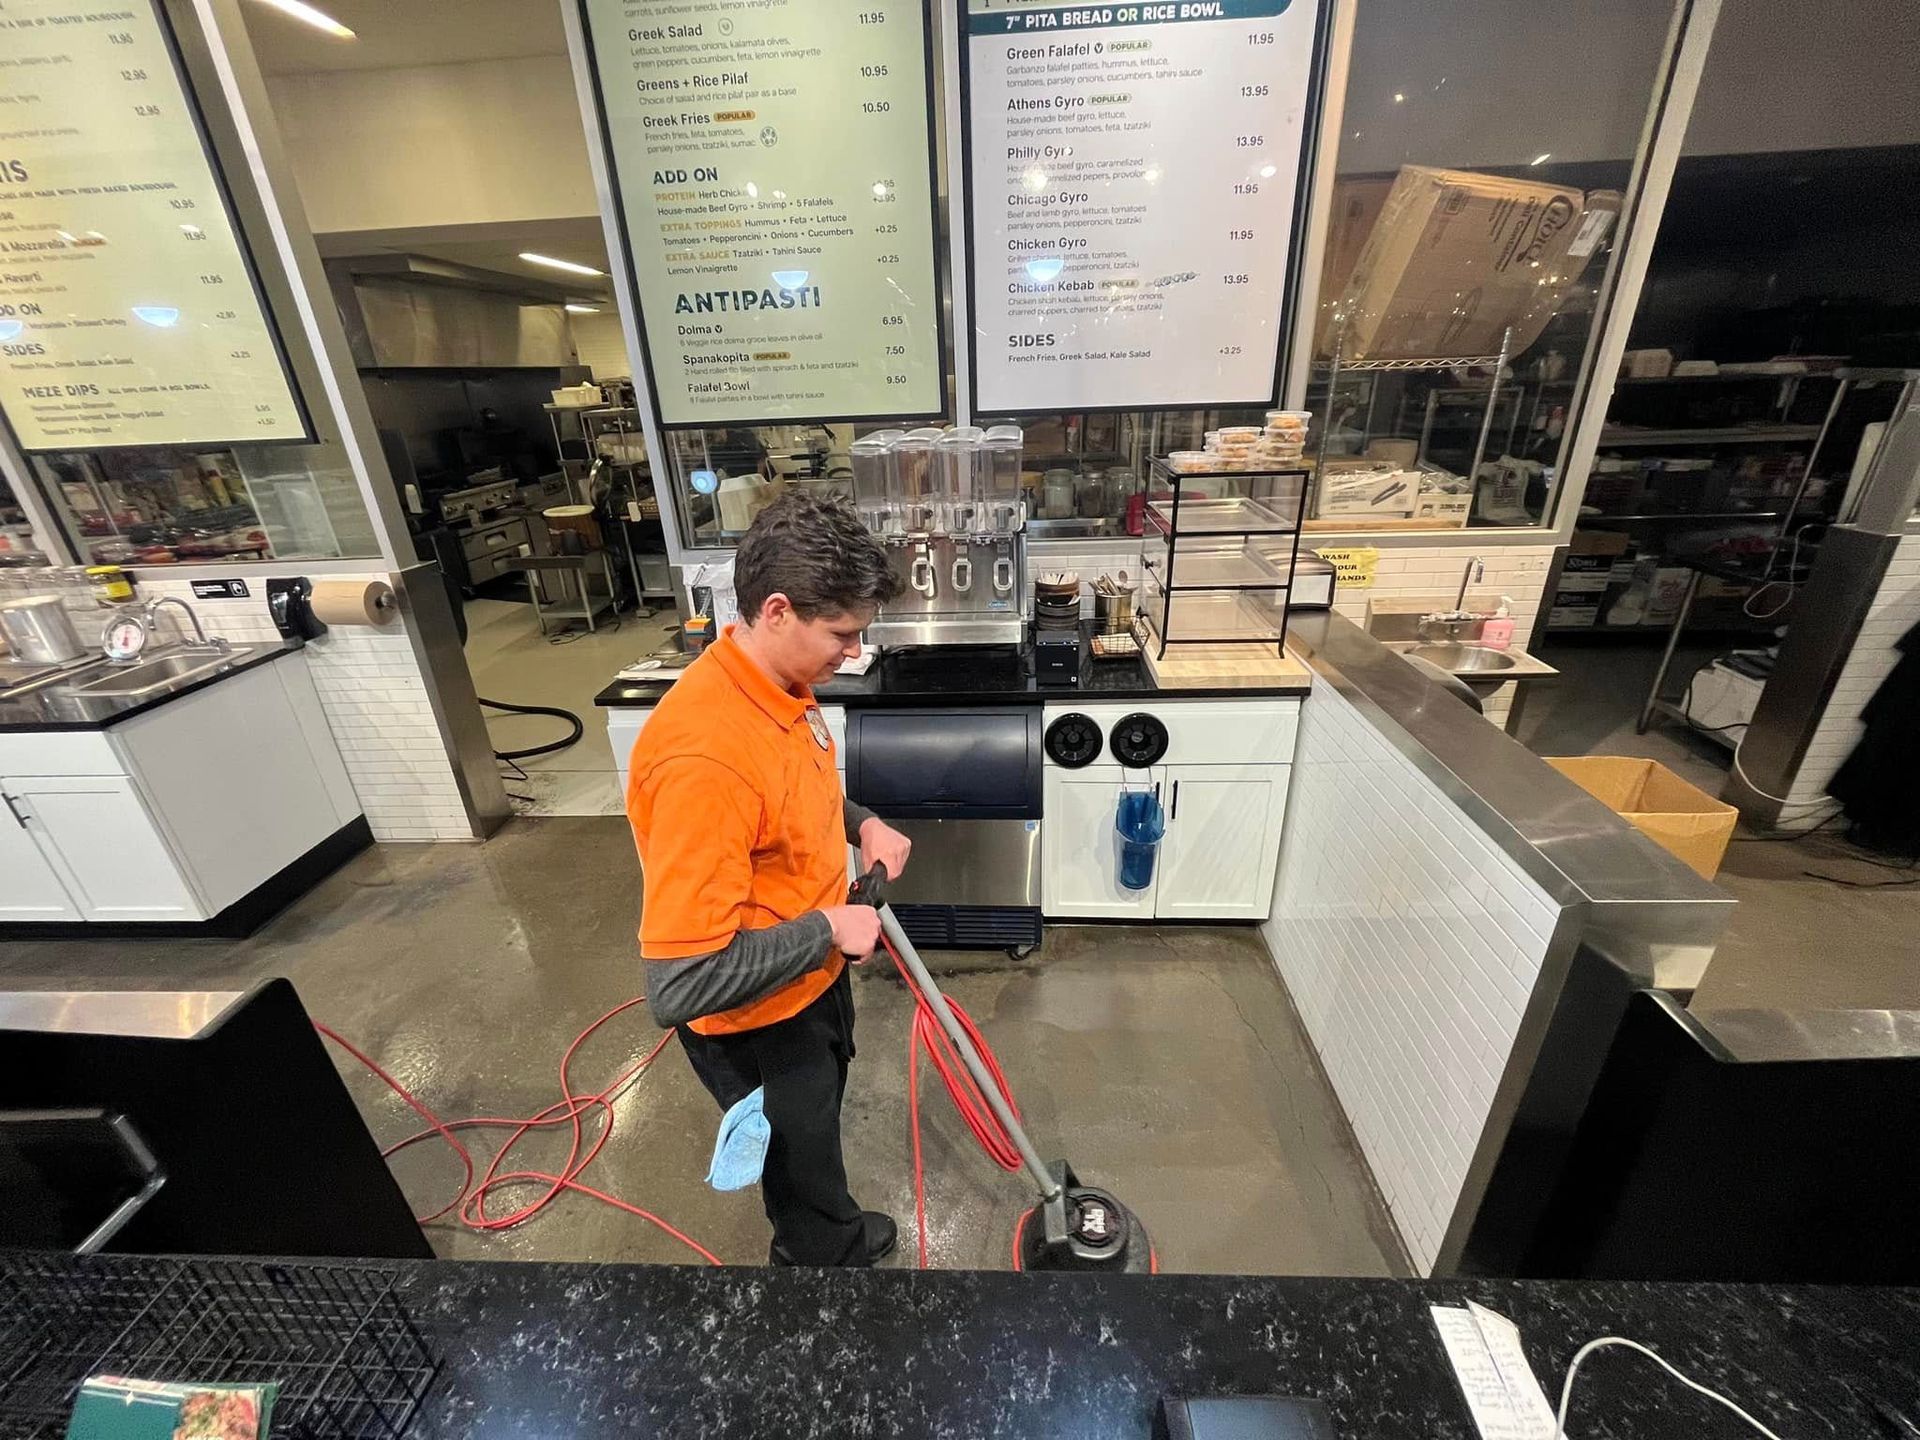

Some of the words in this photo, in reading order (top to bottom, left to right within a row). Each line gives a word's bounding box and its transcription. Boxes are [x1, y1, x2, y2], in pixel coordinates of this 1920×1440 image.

[859, 12, 884, 24] 11.95
[1006, 16, 1021, 30] 7"
[1026, 13, 1057, 28] PITA
[1063, 11, 1112, 26] BREAD
[1117, 8, 1138, 23] OR
[1143, 6, 1175, 21] RICE
[1180, 3, 1224, 18] BOWL
[108, 33, 133, 44] 11.95
[629, 28, 665, 41] Greek
[668, 24, 703, 37] Salad
[1247, 33, 1274, 46] 11.95
[1007, 46, 1045, 60] Green
[1049, 42, 1090, 57] Falafel
[1111, 41, 1148, 51] POPULAR
[121, 69, 147, 80] 12.95
[860, 65, 888, 78] 10.95
[637, 77, 680, 92] Greens
[693, 74, 719, 88] Rice
[722, 72, 748, 85] Pilaf
[1241, 86, 1268, 98] 13.95
[862, 102, 890, 113] 10.50
[1007, 98, 1050, 110] Athens
[1055, 96, 1084, 110] Gyro
[1091, 95, 1128, 104] POPULAR
[134, 105, 160, 116] 12.95
[643, 115, 679, 128] Greek
[681, 113, 710, 125] Fries
[716, 111, 752, 121] POPULAR
[1236, 136, 1264, 147] 13.95
[1007, 147, 1041, 160] Philly
[653, 170, 687, 185] ADD
[694, 167, 718, 181] ON
[656, 192, 695, 201] PROTEIN
[699, 191, 718, 199] Herb
[720, 189, 749, 198] Chick
[1233, 183, 1259, 195] 11.95
[1008, 193, 1056, 206] Chicago
[1060, 192, 1088, 205] Gyro
[658, 207, 707, 216] House-made
[729, 204, 747, 212] Gyro
[758, 200, 786, 212] Shrimp
[804, 197, 834, 207] Falafels
[661, 222, 692, 232] EXTRA
[694, 219, 742, 231] TOPPINGS
[745, 218, 780, 228] Hummus
[789, 216, 807, 225] Feta
[816, 213, 847, 223] Lettuce
[876, 225, 897, 233] +0.25
[1229, 229, 1254, 241] 11.95
[663, 236, 700, 247] Tomatoes
[709, 232, 761, 244] Pepperoncini
[771, 230, 798, 240] Onions
[808, 226, 854, 238] Cucumbers
[1008, 238, 1055, 250] Chicken
[1059, 237, 1087, 250] Gyro
[665, 252, 696, 262] EXTRA
[699, 250, 730, 260] SAUCE
[733, 248, 763, 258] Tzatziki
[773, 246, 795, 256] Tahini
[797, 246, 822, 255] Sauce
[878, 254, 899, 263] +0.25
[668, 266, 694, 275] Lemon
[696, 263, 738, 275] Vinaigrette
[201, 275, 222, 284] 11.95
[1223, 274, 1248, 285] 13.95
[1008, 282, 1054, 294] Chicken
[1058, 280, 1094, 292] Kebab
[675, 286, 821, 314] ANTIPASTI
[20, 303, 42, 315] ON
[882, 316, 903, 326] 6.95
[678, 325, 712, 335] Dolma
[1008, 334, 1055, 348] SIDES
[3, 344, 45, 356] SIDES
[885, 346, 904, 355] 7.50
[683, 352, 750, 366] Spanakopita
[1008, 354, 1035, 363] French
[1037, 353, 1057, 362] Fries,
[1059, 352, 1082, 361] Greek
[1084, 351, 1108, 360] Salad,
[1110, 351, 1128, 359] Kale
[1130, 350, 1151, 358] Salad
[886, 375, 907, 385] 9.50
[22, 387, 63, 398] MEZE
[66, 384, 100, 396] DIPS
[688, 382, 722, 393] Falafel
